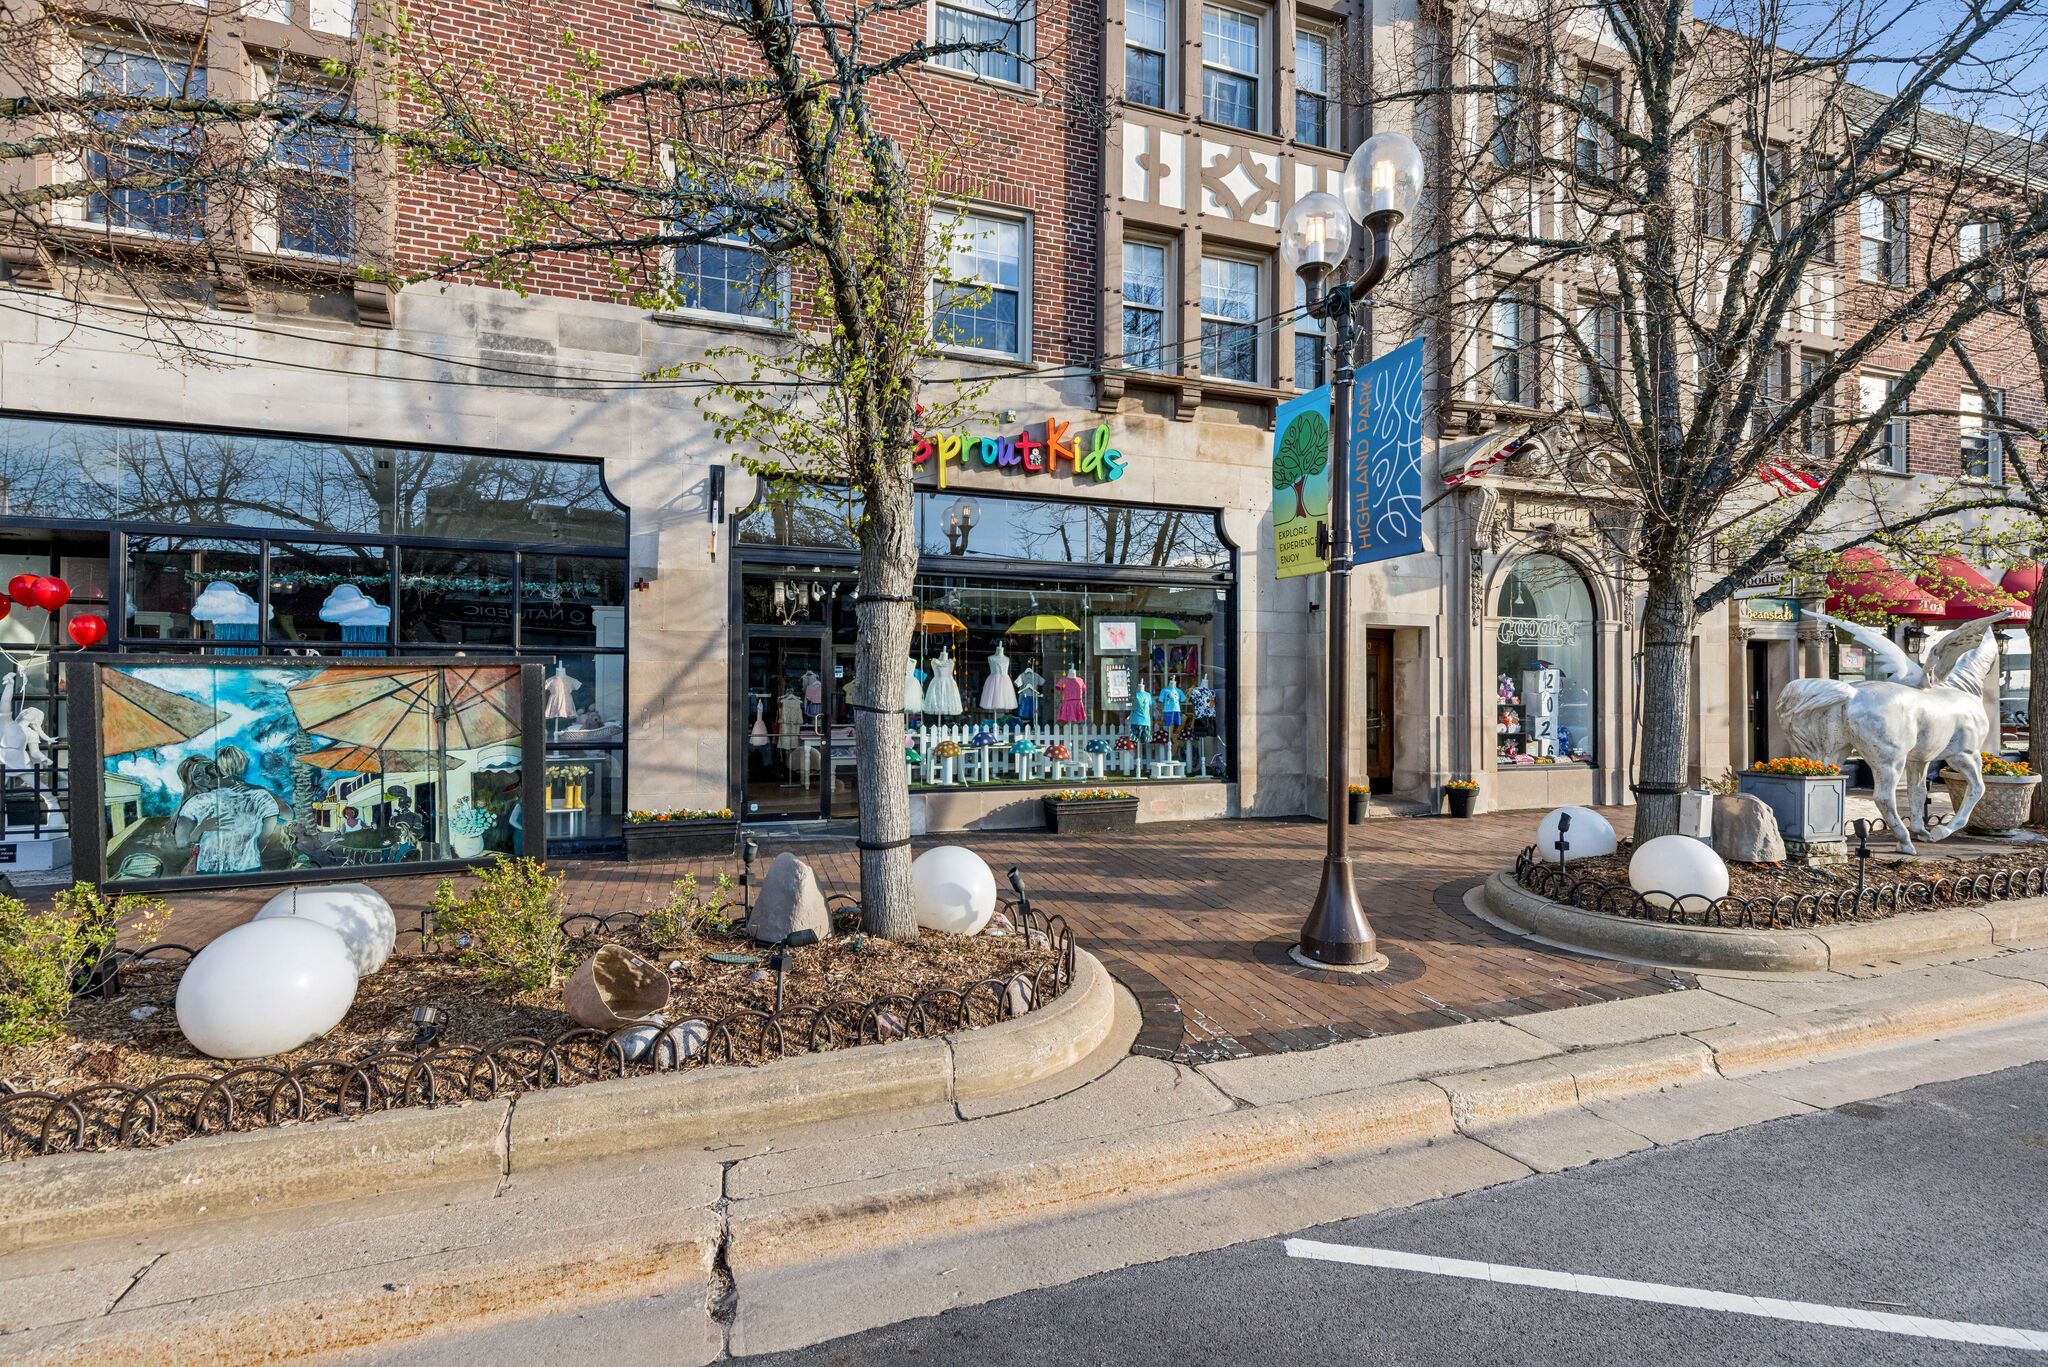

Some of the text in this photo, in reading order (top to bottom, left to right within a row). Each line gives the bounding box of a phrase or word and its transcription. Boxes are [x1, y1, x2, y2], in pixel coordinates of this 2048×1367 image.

[1045, 416, 1129, 482] Kids
[1356, 376, 1374, 549] HIGHLAND PARK
[1278, 526, 1308, 540] EXPLORE
[1280, 553, 1300, 564] ENJOY
[1498, 614, 1580, 646] Goodies
